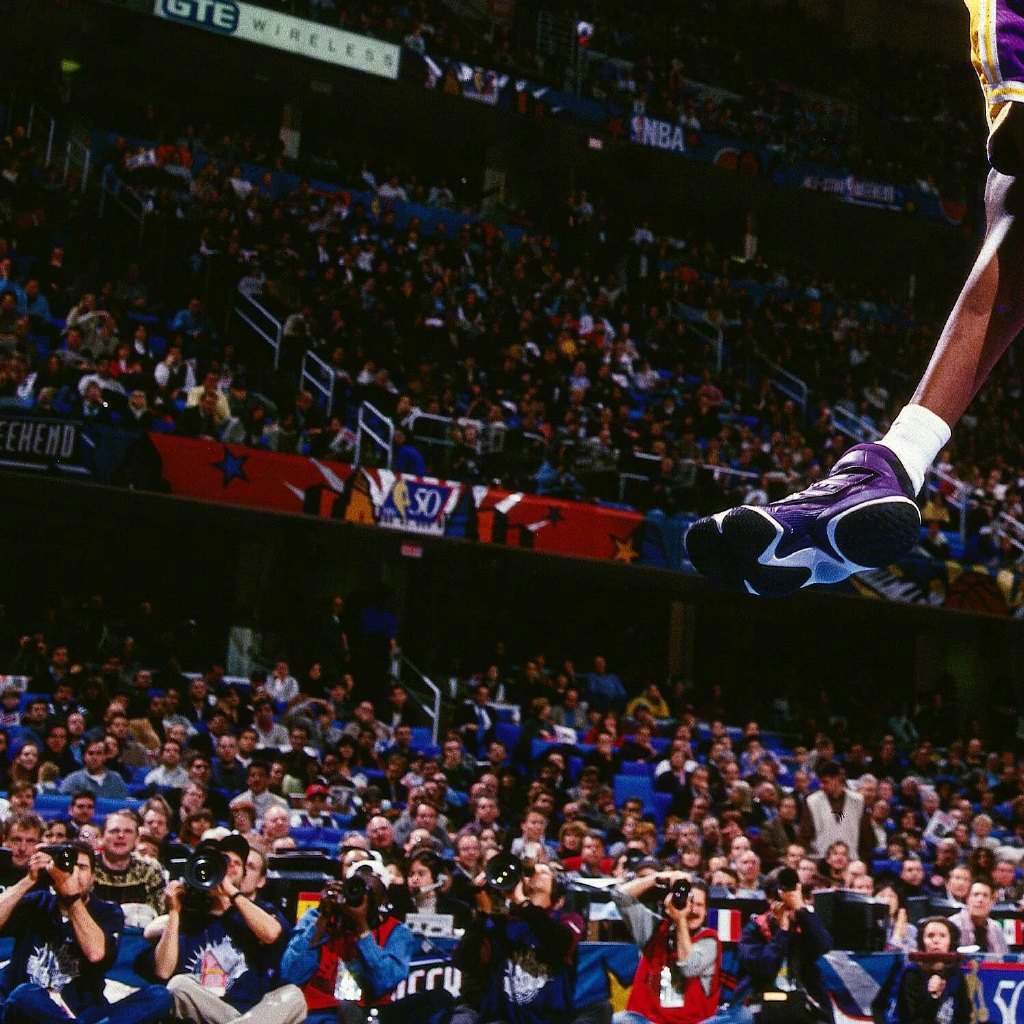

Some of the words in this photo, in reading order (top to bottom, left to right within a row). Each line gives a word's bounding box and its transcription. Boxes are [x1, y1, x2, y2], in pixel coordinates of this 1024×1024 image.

[252, 16, 395, 69] WIRELESS
[644, 116, 685, 153] NBA
[407, 488, 442, 519] 50
